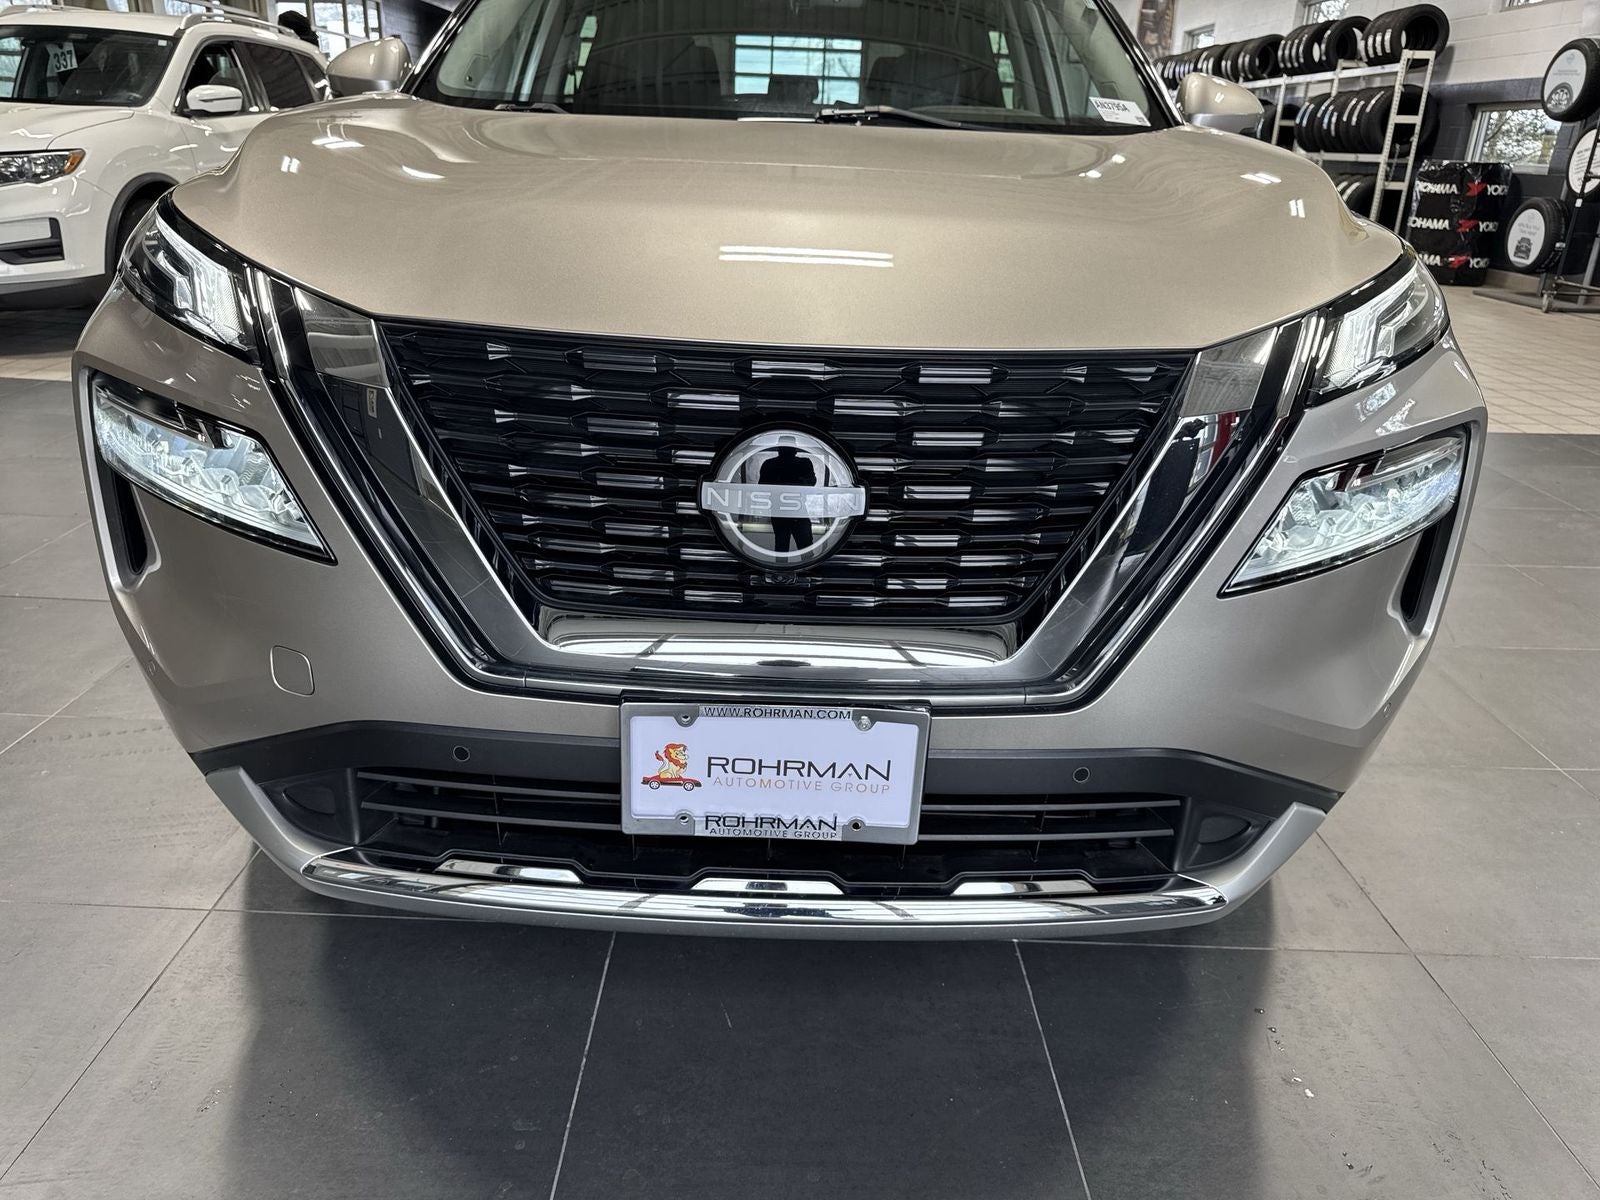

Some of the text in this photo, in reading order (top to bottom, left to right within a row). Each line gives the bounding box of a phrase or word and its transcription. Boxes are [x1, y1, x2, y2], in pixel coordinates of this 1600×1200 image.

[53, 49, 73, 70] 337
[707, 487, 859, 512] NISSN
[704, 706, 851, 720] WWW.ROHRMAN.COM
[707, 756, 891, 782] ROHRMAN
[713, 776, 890, 795] AUTOMOTIVE GROUP
[705, 815, 837, 831] ROHRMAN
[709, 828, 837, 839] AUTOMOTIVE GROUP
